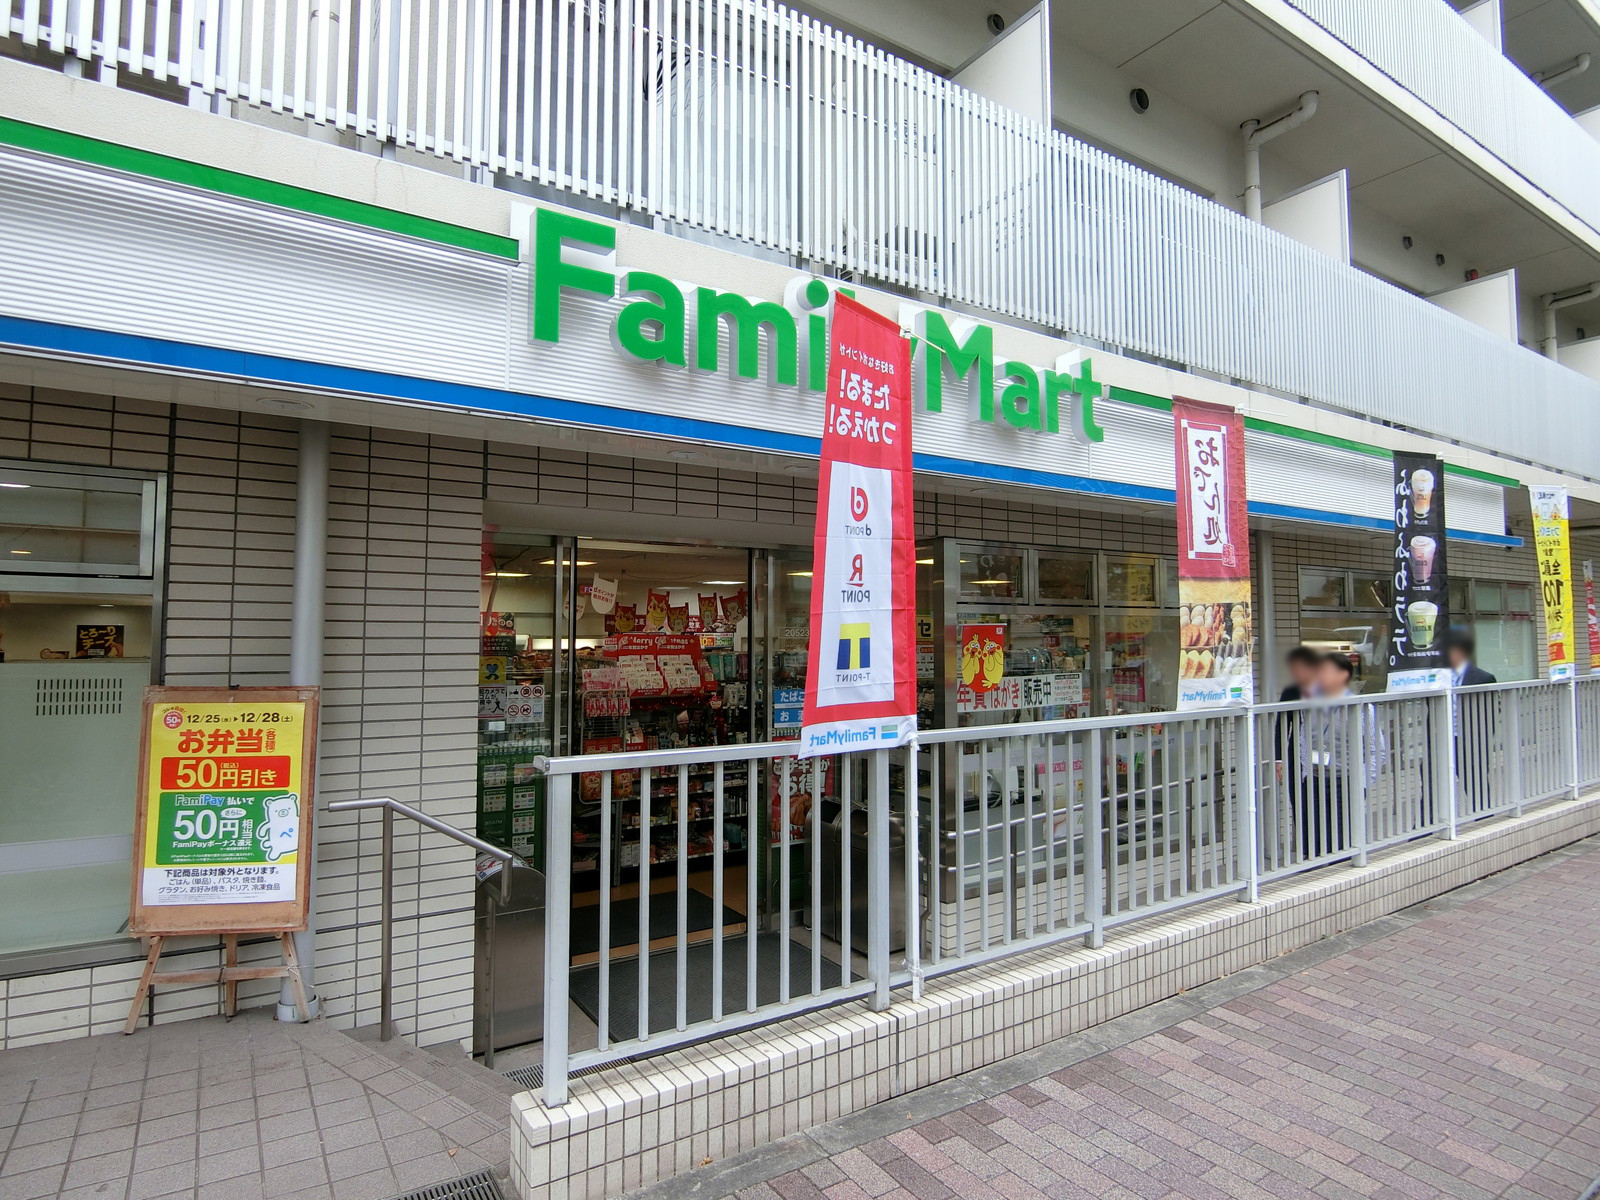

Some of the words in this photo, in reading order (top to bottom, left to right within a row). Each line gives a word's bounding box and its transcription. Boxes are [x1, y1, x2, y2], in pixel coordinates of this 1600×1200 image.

[528, 206, 1104, 443] FamiMart
[82, 635, 117, 650] チーズ
[1023, 674, 1052, 707] 販売中
[240, 712, 293, 723] 12/28(土)
[178, 728, 263, 754] お弁当
[176, 759, 277, 788] 50円引き
[175, 793, 225, 807] FamiPay
[227, 797, 255, 806] 払いで
[173, 809, 240, 840] 50円
[242, 819, 253, 839] 相当
[164, 866, 280, 878] 下記商品は対象外となります。
